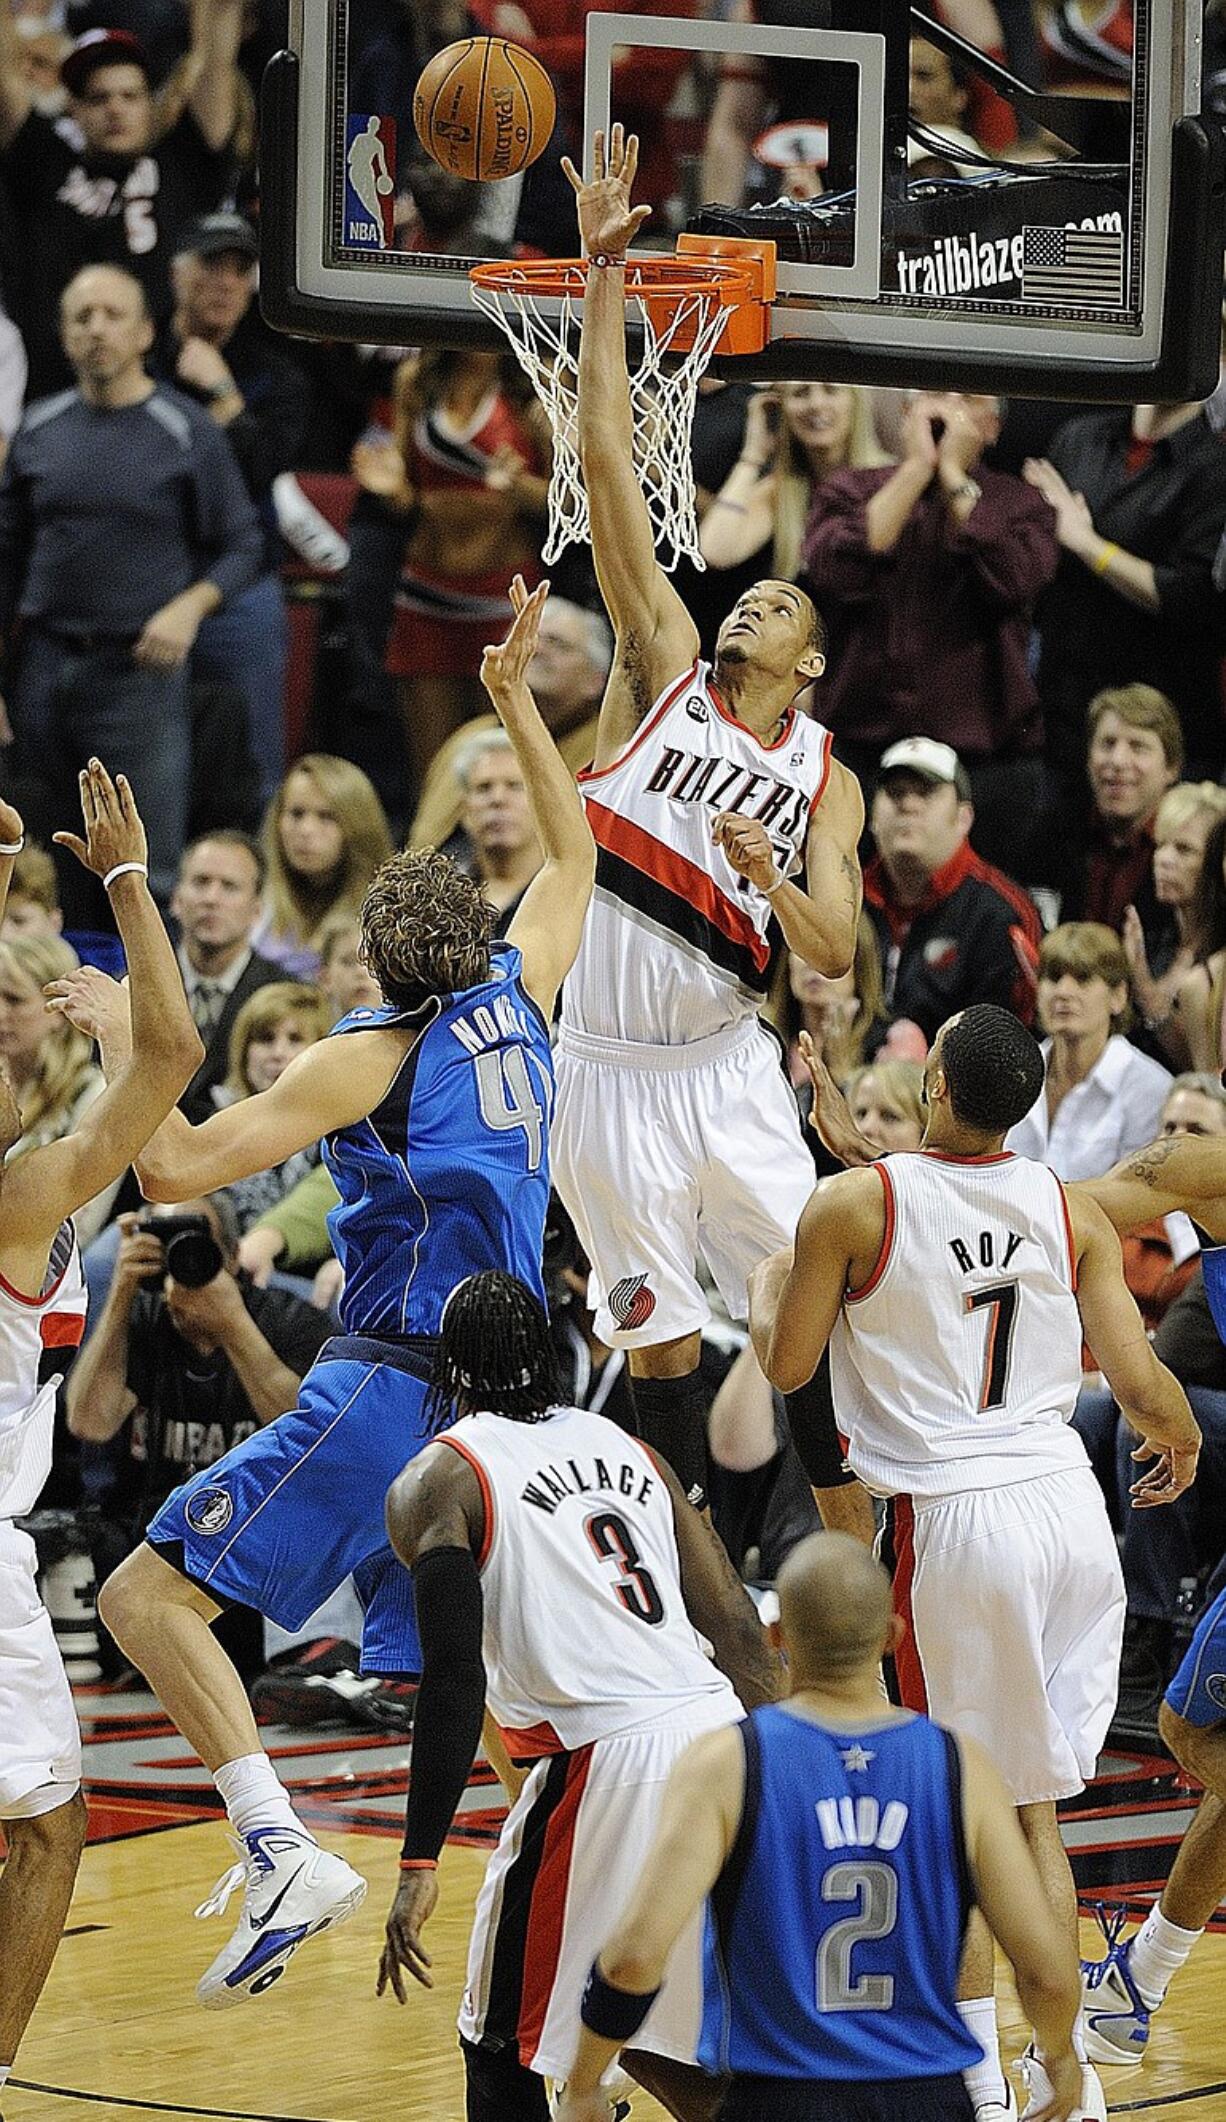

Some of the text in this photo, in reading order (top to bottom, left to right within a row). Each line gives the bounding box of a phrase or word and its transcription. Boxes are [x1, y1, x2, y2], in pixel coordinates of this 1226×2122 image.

[487, 86, 516, 176] SPALDING
[349, 221, 378, 242] NBA
[688, 697, 710, 721] 20
[643, 744, 813, 838] BLAZERS
[948, 1230, 1025, 1274] ROY
[961, 1278, 1023, 1415] 7
[520, 1457, 654, 1516] WALLACE
[582, 1507, 669, 1631] 3
[815, 1860, 899, 2013] 2
